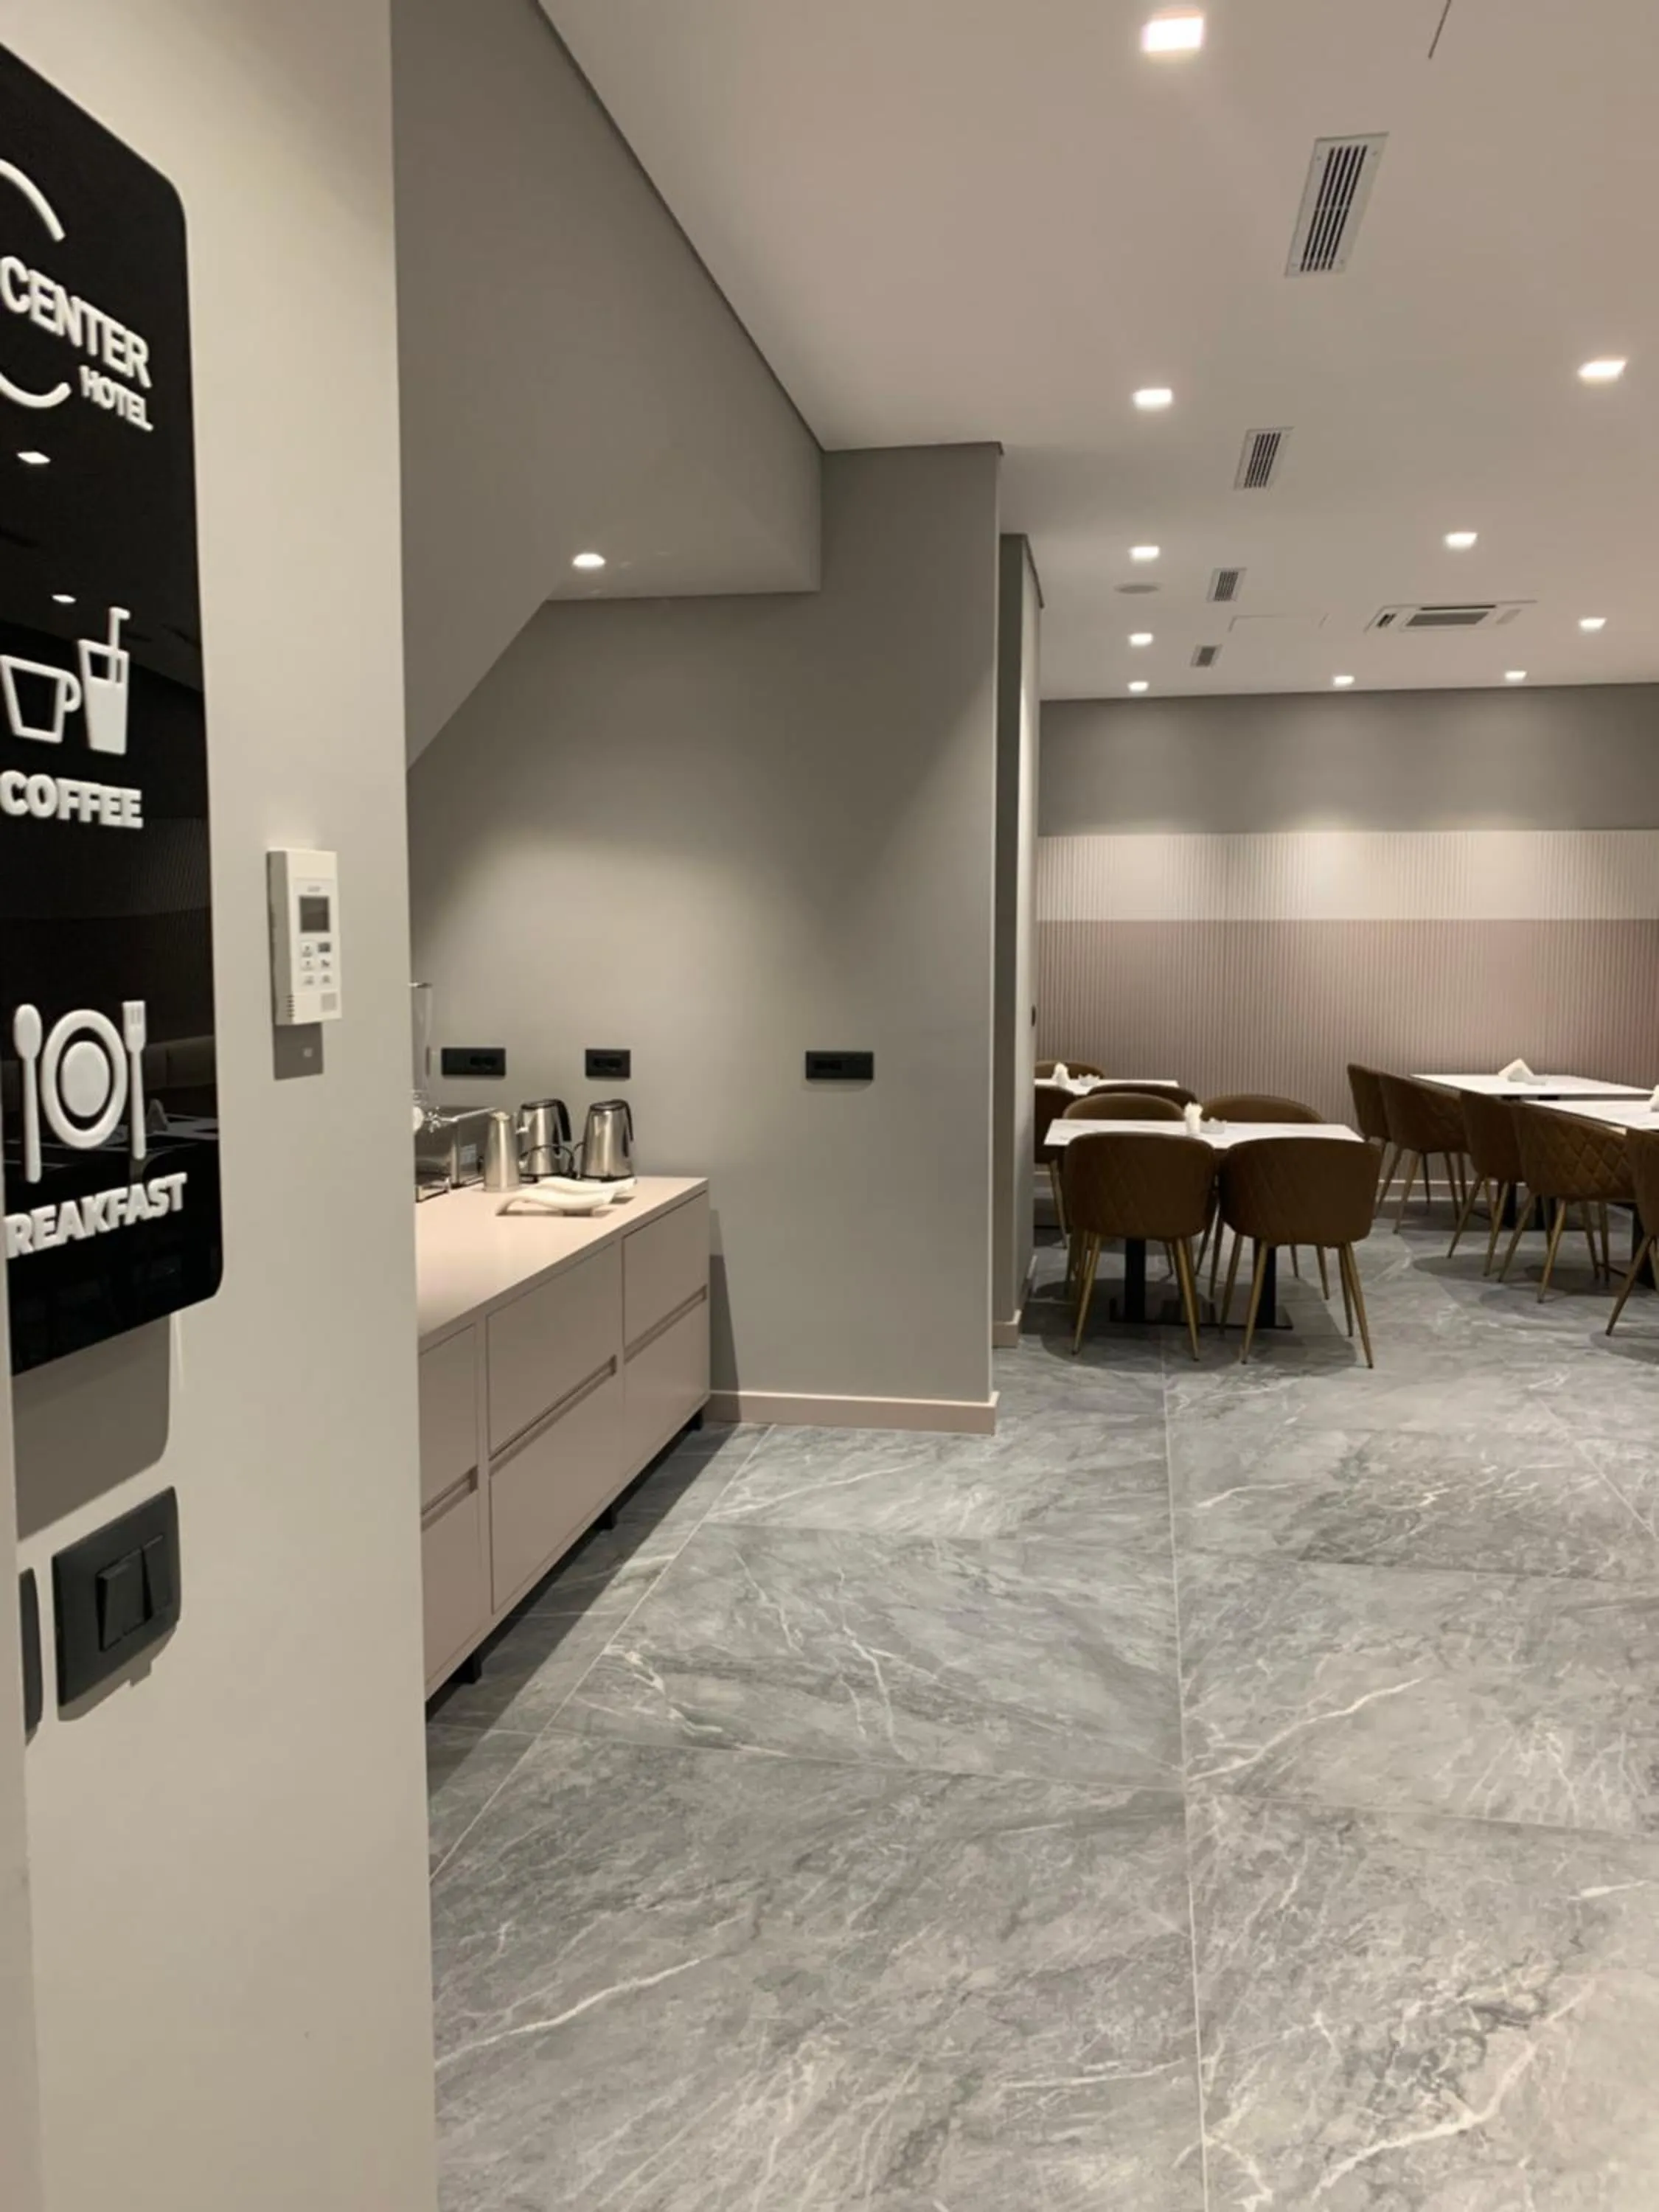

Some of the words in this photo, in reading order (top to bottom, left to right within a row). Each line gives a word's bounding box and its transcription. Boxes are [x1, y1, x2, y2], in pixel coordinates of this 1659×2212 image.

[0, 256, 152, 388] CENTER
[79, 365, 153, 431] HOTEL
[0, 770, 143, 829] COFFEE
[3, 1172, 187, 1259] REAKFAST
